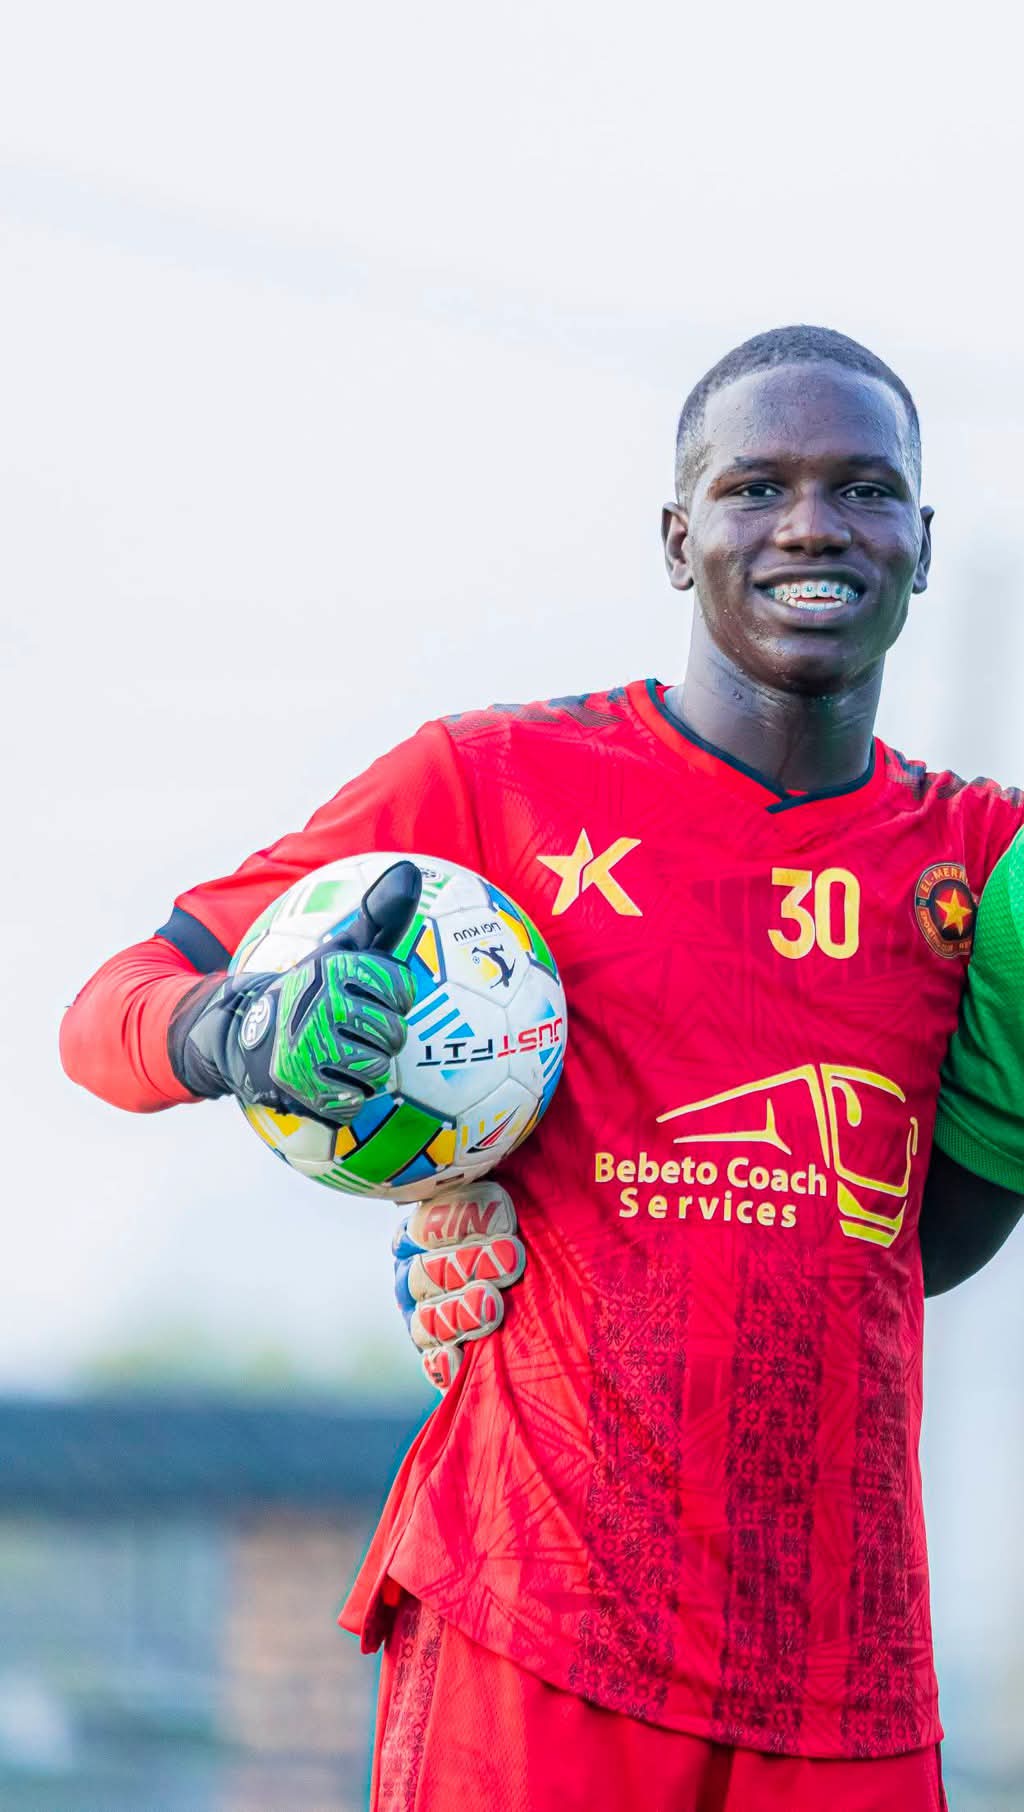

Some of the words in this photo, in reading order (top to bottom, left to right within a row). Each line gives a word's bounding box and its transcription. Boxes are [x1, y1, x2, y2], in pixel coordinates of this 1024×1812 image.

[768, 867, 860, 959] 30
[594, 1152, 718, 1185] Bebeto
[727, 1157, 827, 1196] Coach
[619, 1187, 798, 1228] Services
